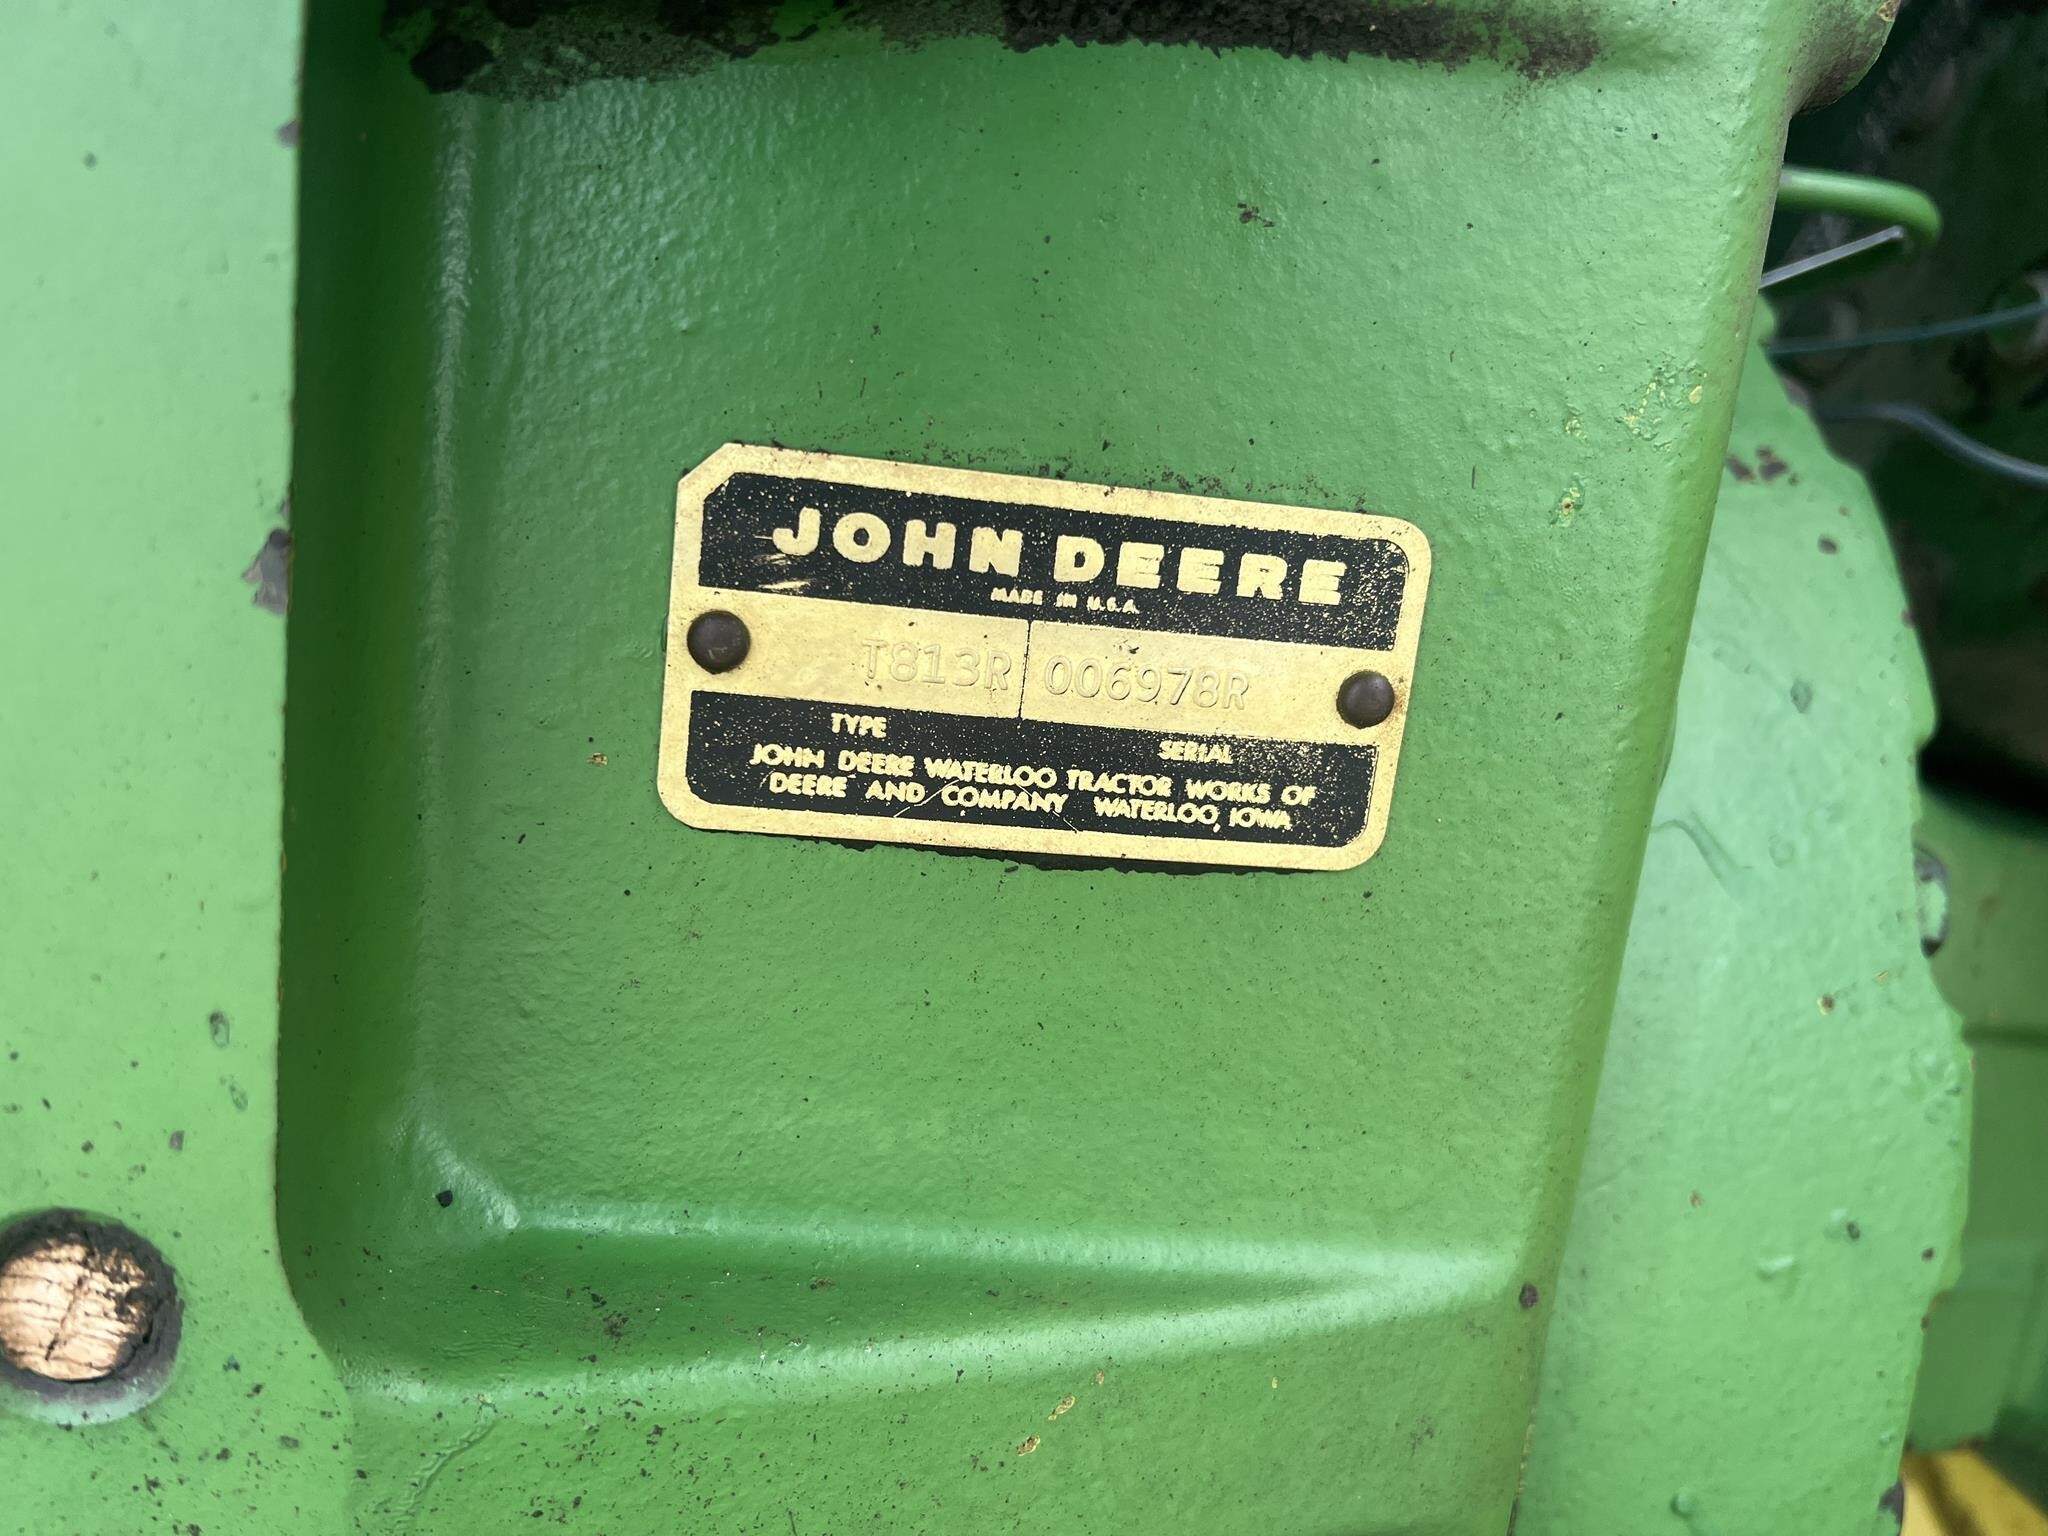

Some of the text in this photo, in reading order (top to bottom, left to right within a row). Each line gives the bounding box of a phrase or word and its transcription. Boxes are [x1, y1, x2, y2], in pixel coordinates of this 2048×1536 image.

[772, 506, 1348, 606] JOHN DEERE
[991, 587, 1043, 605] MADE
[1055, 591, 1077, 609] IN
[861, 638, 1012, 690] T813R
[1044, 655, 1250, 710] 006978R
[831, 712, 887, 738] TYPE
[750, 743, 1317, 806] JOHN DEERE WATERLOO TRACTOR WORKS OF
[1157, 740, 1234, 764] SERIAL
[769, 772, 848, 798] DEERE
[865, 779, 926, 803] AND
[941, 785, 1069, 813] COMPANY
[1094, 796, 1220, 832] WATERLOO,
